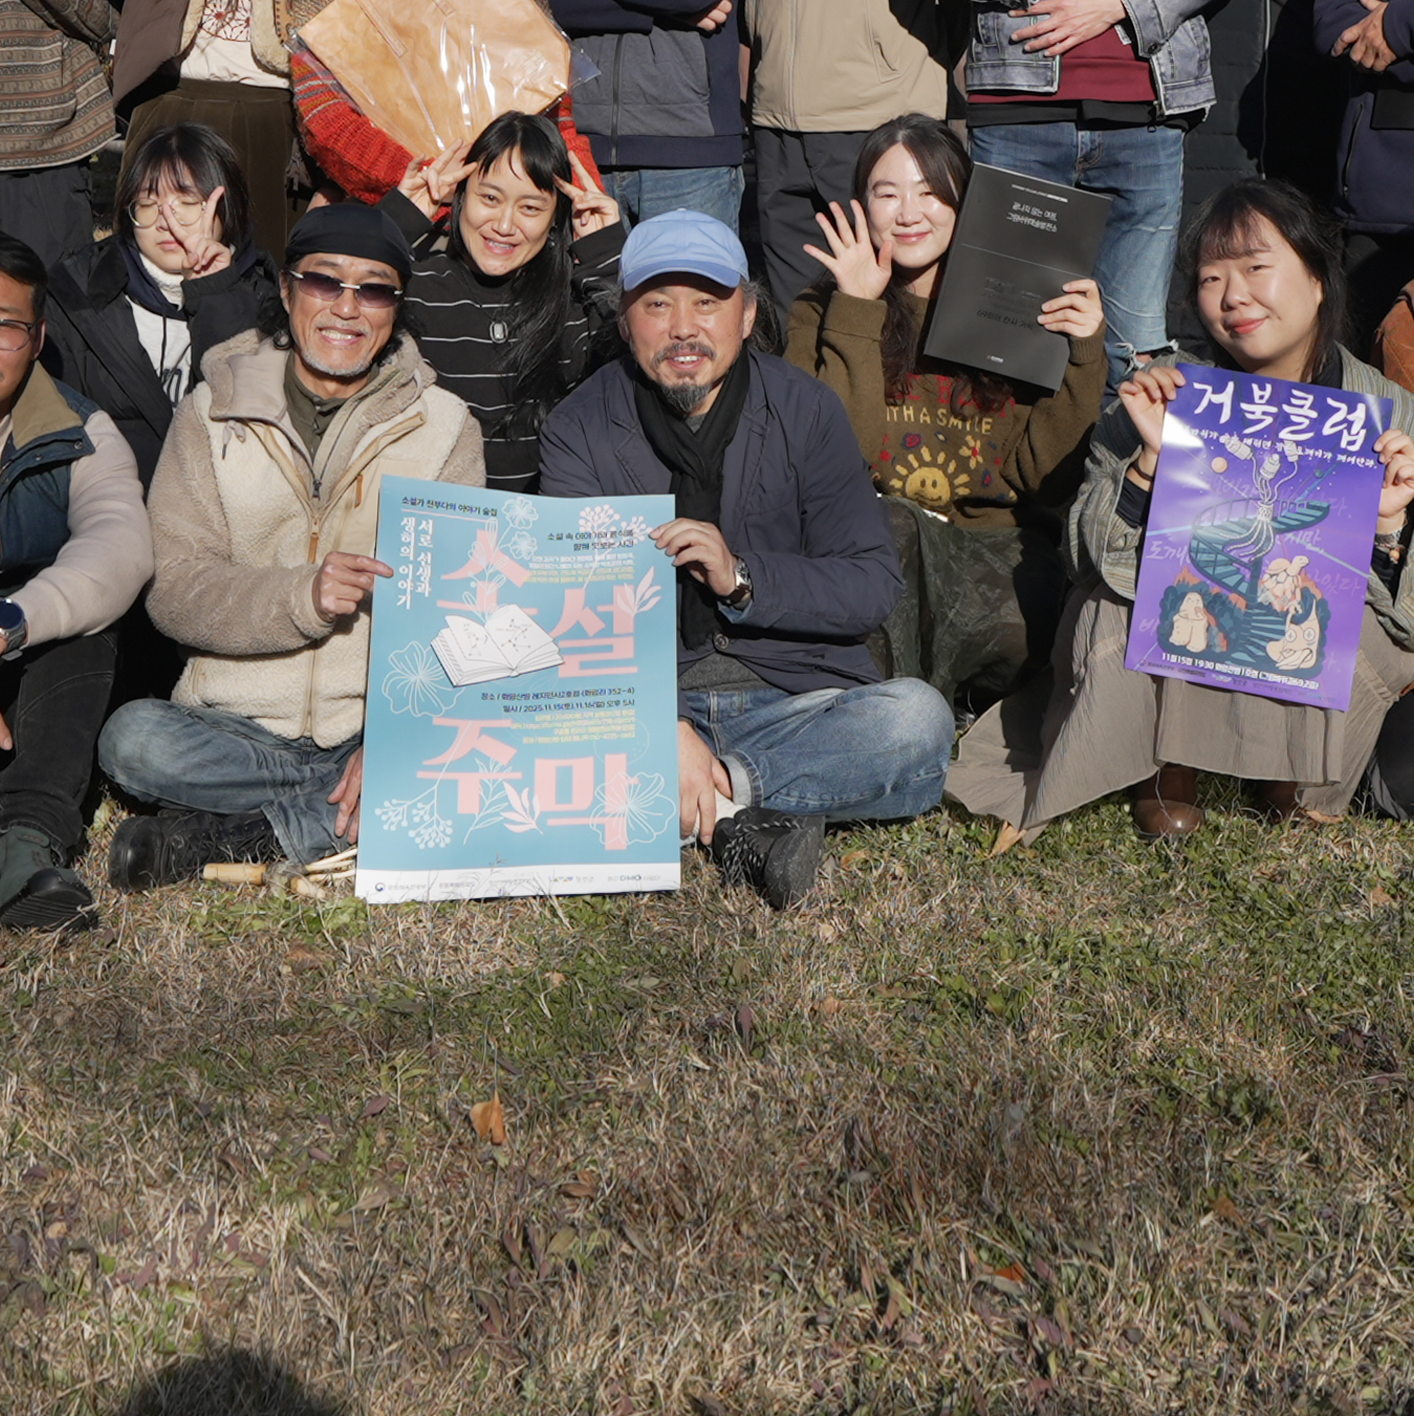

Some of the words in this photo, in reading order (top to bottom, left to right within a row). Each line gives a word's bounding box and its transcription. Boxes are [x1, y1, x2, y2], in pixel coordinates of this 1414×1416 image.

[1193, 381, 1366, 452] 거북클럽
[418, 518, 435, 548] 서로
[396, 563, 414, 610] 이야기
[415, 550, 433, 598] 선생과
[435, 526, 639, 678] 소설
[416, 714, 640, 852] 주막
